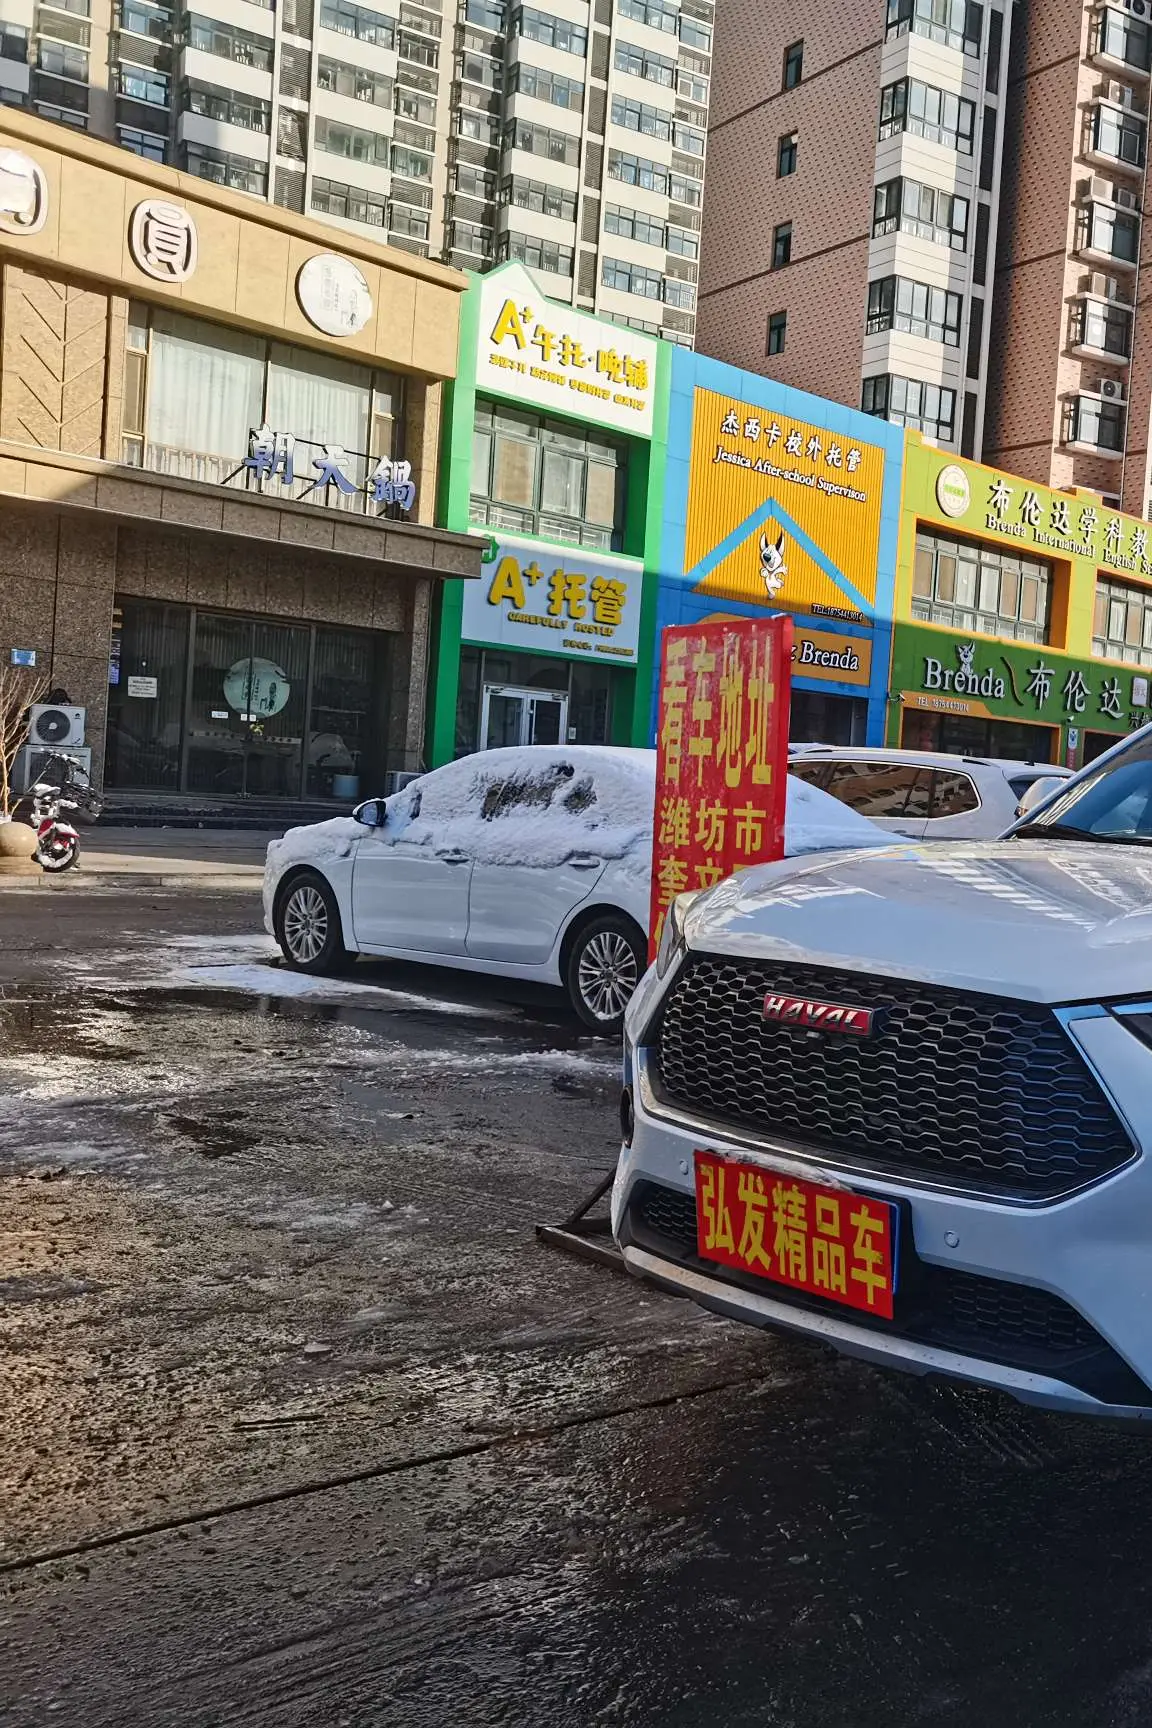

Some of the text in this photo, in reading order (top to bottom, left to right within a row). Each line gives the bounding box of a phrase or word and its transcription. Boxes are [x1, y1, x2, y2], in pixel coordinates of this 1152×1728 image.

[720, 409, 862, 472] 杰西卡校外托管
[713, 445, 867, 502] Jessica After-school Supervison
[985, 514, 1027, 538] Brenda
[1033, 528, 1096, 557] International
[1103, 549, 1136, 571] English
[800, 641, 859, 671] Brenda
[924, 656, 1005, 700] Brenda
[1026, 660, 1125, 720] 布伦达
[658, 795, 767, 856] 潍坊市
[658, 855, 755, 905] 奎文
[765, 995, 864, 1031] HAVAL
[700, 1163, 888, 1306] 弘发精品车
